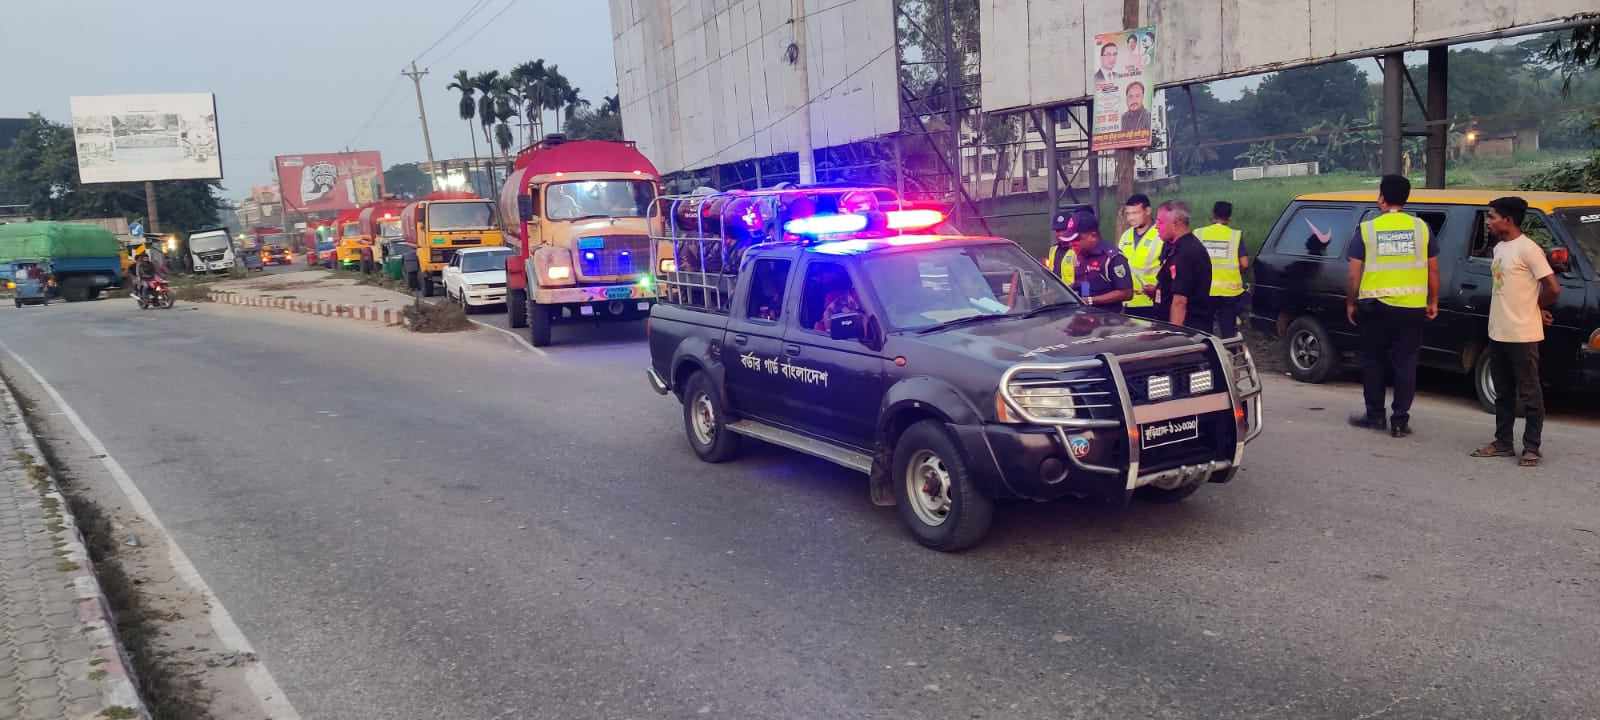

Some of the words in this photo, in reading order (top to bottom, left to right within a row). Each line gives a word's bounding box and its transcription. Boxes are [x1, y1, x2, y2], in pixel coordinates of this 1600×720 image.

[1378, 241, 1416, 255] POLICE
[740, 352, 760, 371] বর্ডার
[764, 357, 779, 375] গার্ড
[780, 358, 828, 387] বাংলাদেশ
